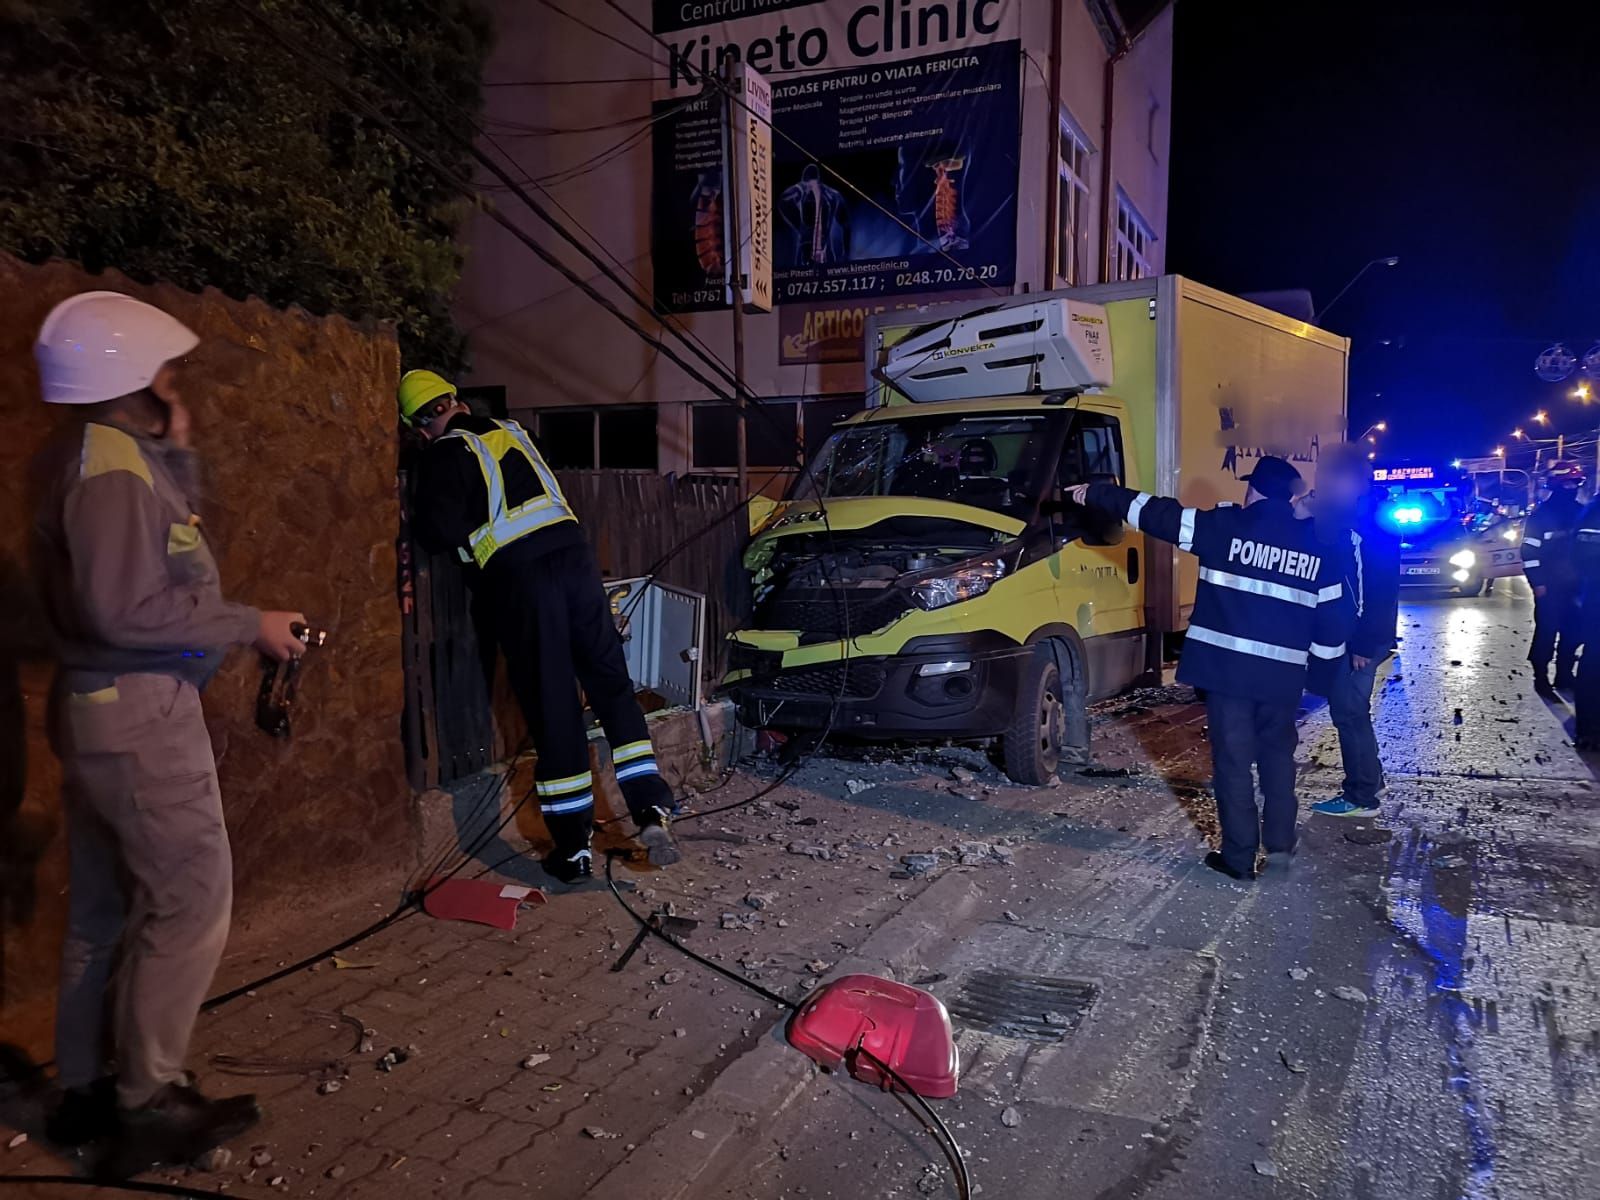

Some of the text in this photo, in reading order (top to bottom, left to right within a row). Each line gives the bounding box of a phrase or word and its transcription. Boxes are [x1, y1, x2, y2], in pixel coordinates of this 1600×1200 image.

[680, 0, 747, 22] Centrul
[670, 0, 1000, 93] Kineto Clinic
[822, 73, 867, 90] PENTRU
[871, 71, 882, 84] O
[884, 64, 922, 80] VIATA
[926, 55, 980, 73] FERICITA
[747, 77, 770, 107] LIVING
[875, 89, 893, 98] unde
[963, 83, 1002, 96] musculara
[904, 128, 943, 140] alimentara
[827, 260, 909, 276] www.kinetoclinic.ro
[787, 276, 876, 296] 0747.557.117
[896, 264, 998, 287] 0248.70.70.20
[944, 343, 995, 357] KONVEKTA
[1228, 537, 1321, 582] POMPIERII
